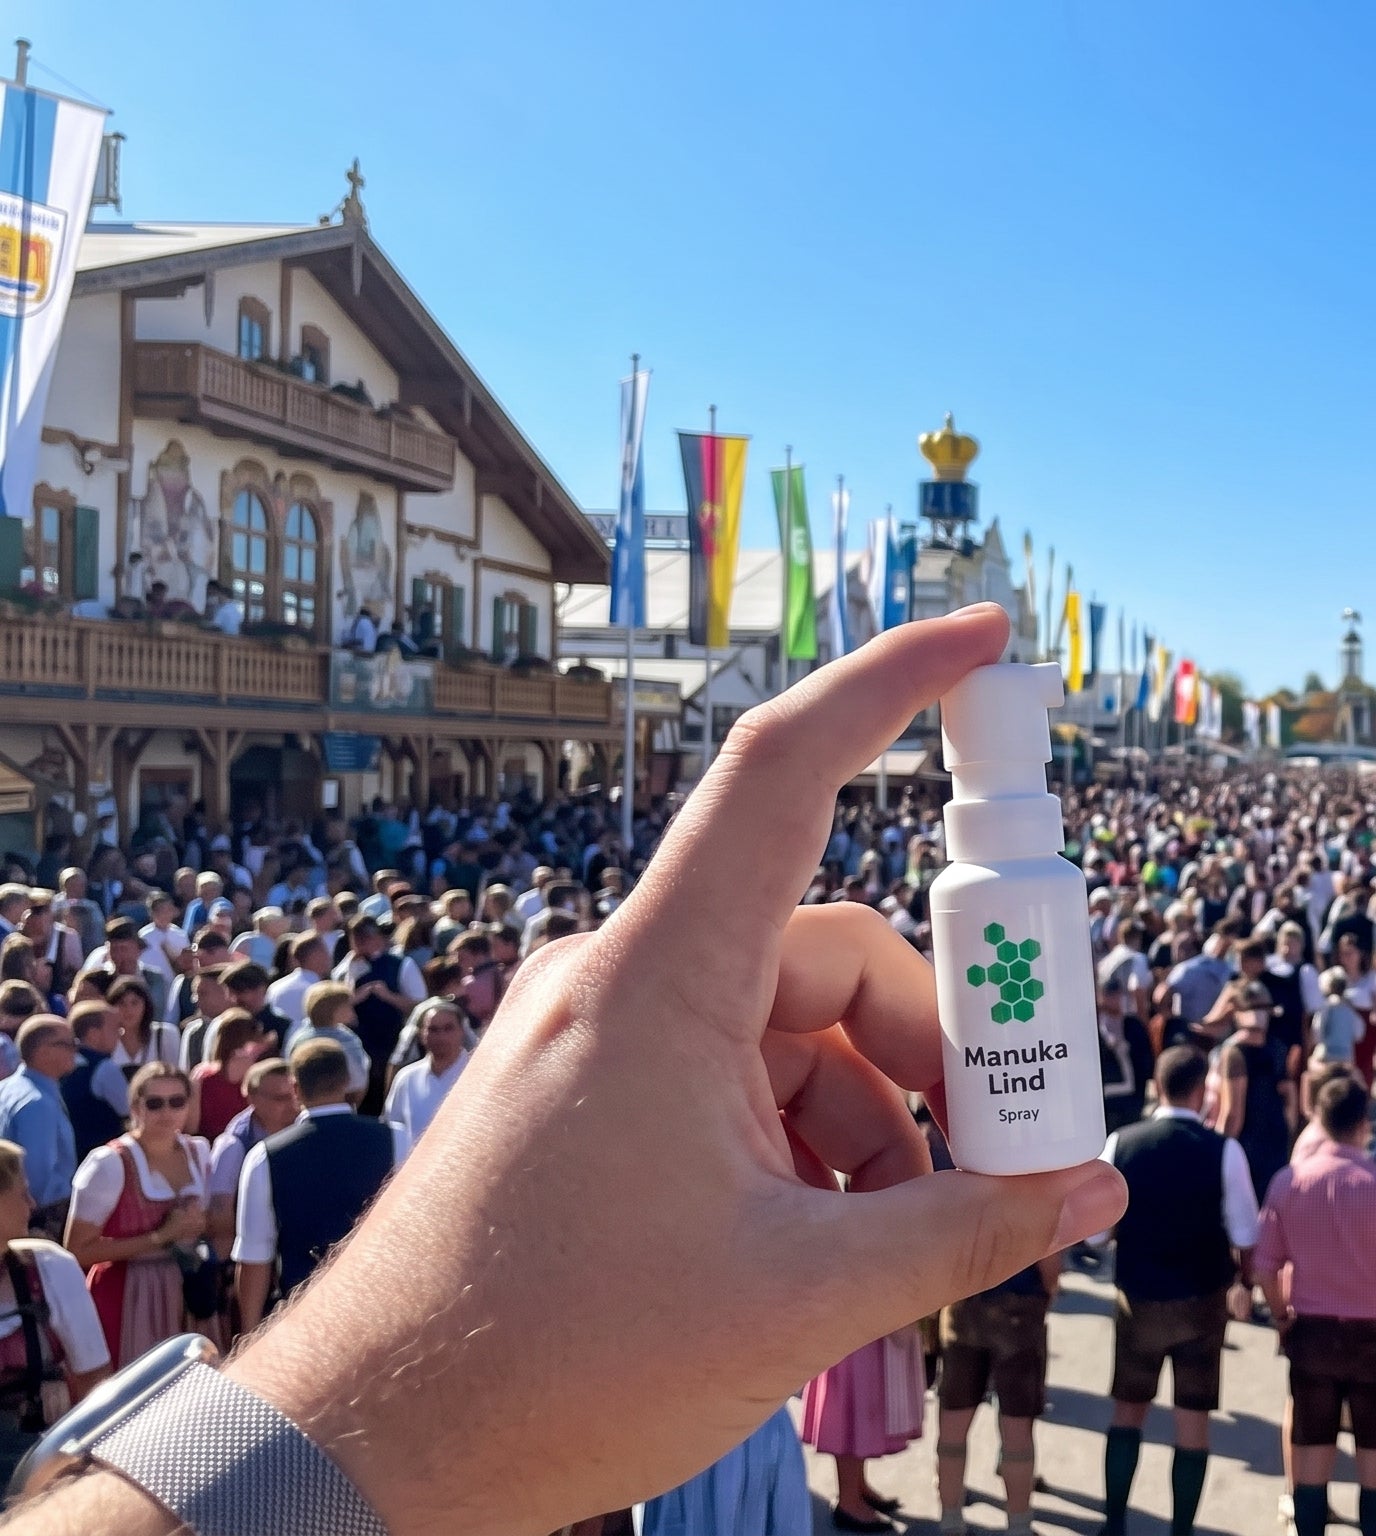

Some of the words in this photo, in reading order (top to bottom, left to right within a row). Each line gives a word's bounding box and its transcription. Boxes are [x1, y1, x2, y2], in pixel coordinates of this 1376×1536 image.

[964, 1040, 1068, 1068] Manuka
[988, 1067, 1046, 1095] Lind
[998, 1108, 1040, 1124] Spray
